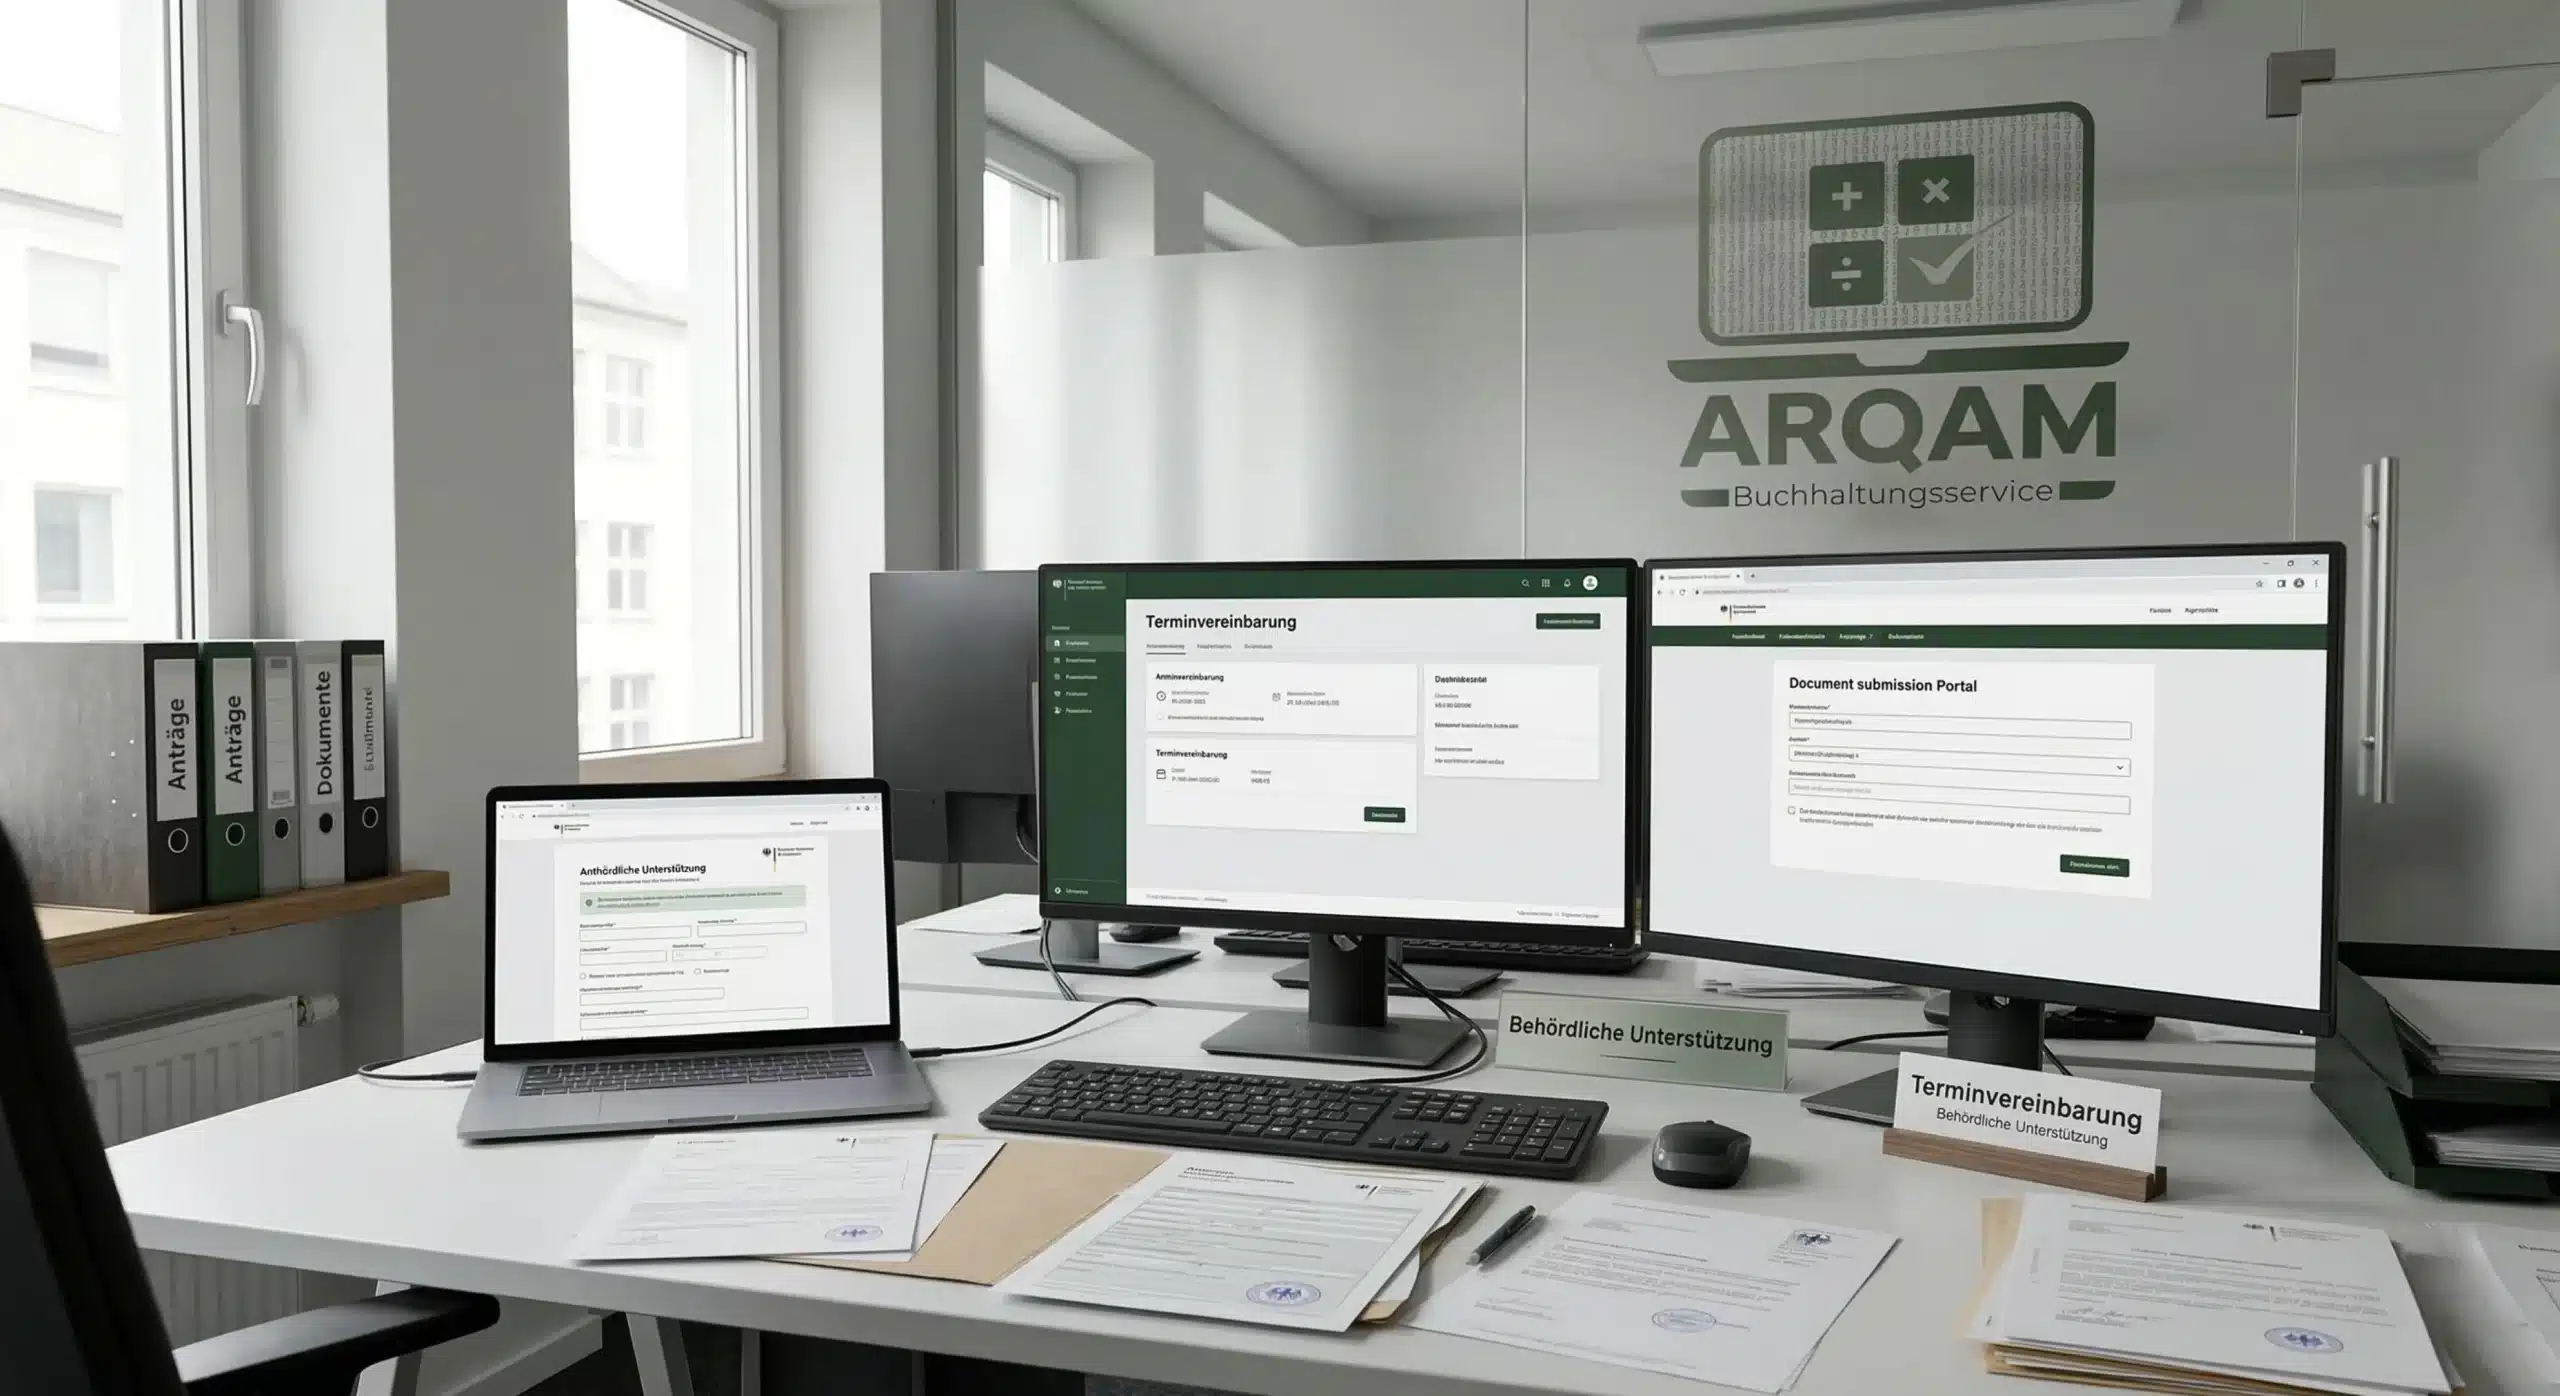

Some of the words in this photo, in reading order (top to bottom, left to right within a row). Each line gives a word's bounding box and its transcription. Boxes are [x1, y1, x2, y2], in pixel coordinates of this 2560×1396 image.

[1680, 381, 2117, 474] ARQAM
[1734, 480, 2054, 509] Buchhaltungsservice
[1145, 613, 1297, 632] Terminvereinbarung
[1789, 677, 1854, 690] Document
[1857, 677, 1933, 692] submission
[1936, 678, 1978, 693] Portal
[166, 698, 190, 791] Anträge
[225, 695, 247, 785] Anträge
[316, 671, 333, 796] Dokumente
[1155, 748, 1228, 761] Terminvereinbarung
[642, 863, 707, 875] Unterstützung
[1509, 1015, 1625, 1042] Behördliche
[1630, 1025, 1773, 1057] Unterstützung
[1911, 1074, 2143, 1135] Terminvereinbarung
[1937, 1107, 2012, 1131] Behördliche
[2016, 1120, 2109, 1149] Unterstützung
